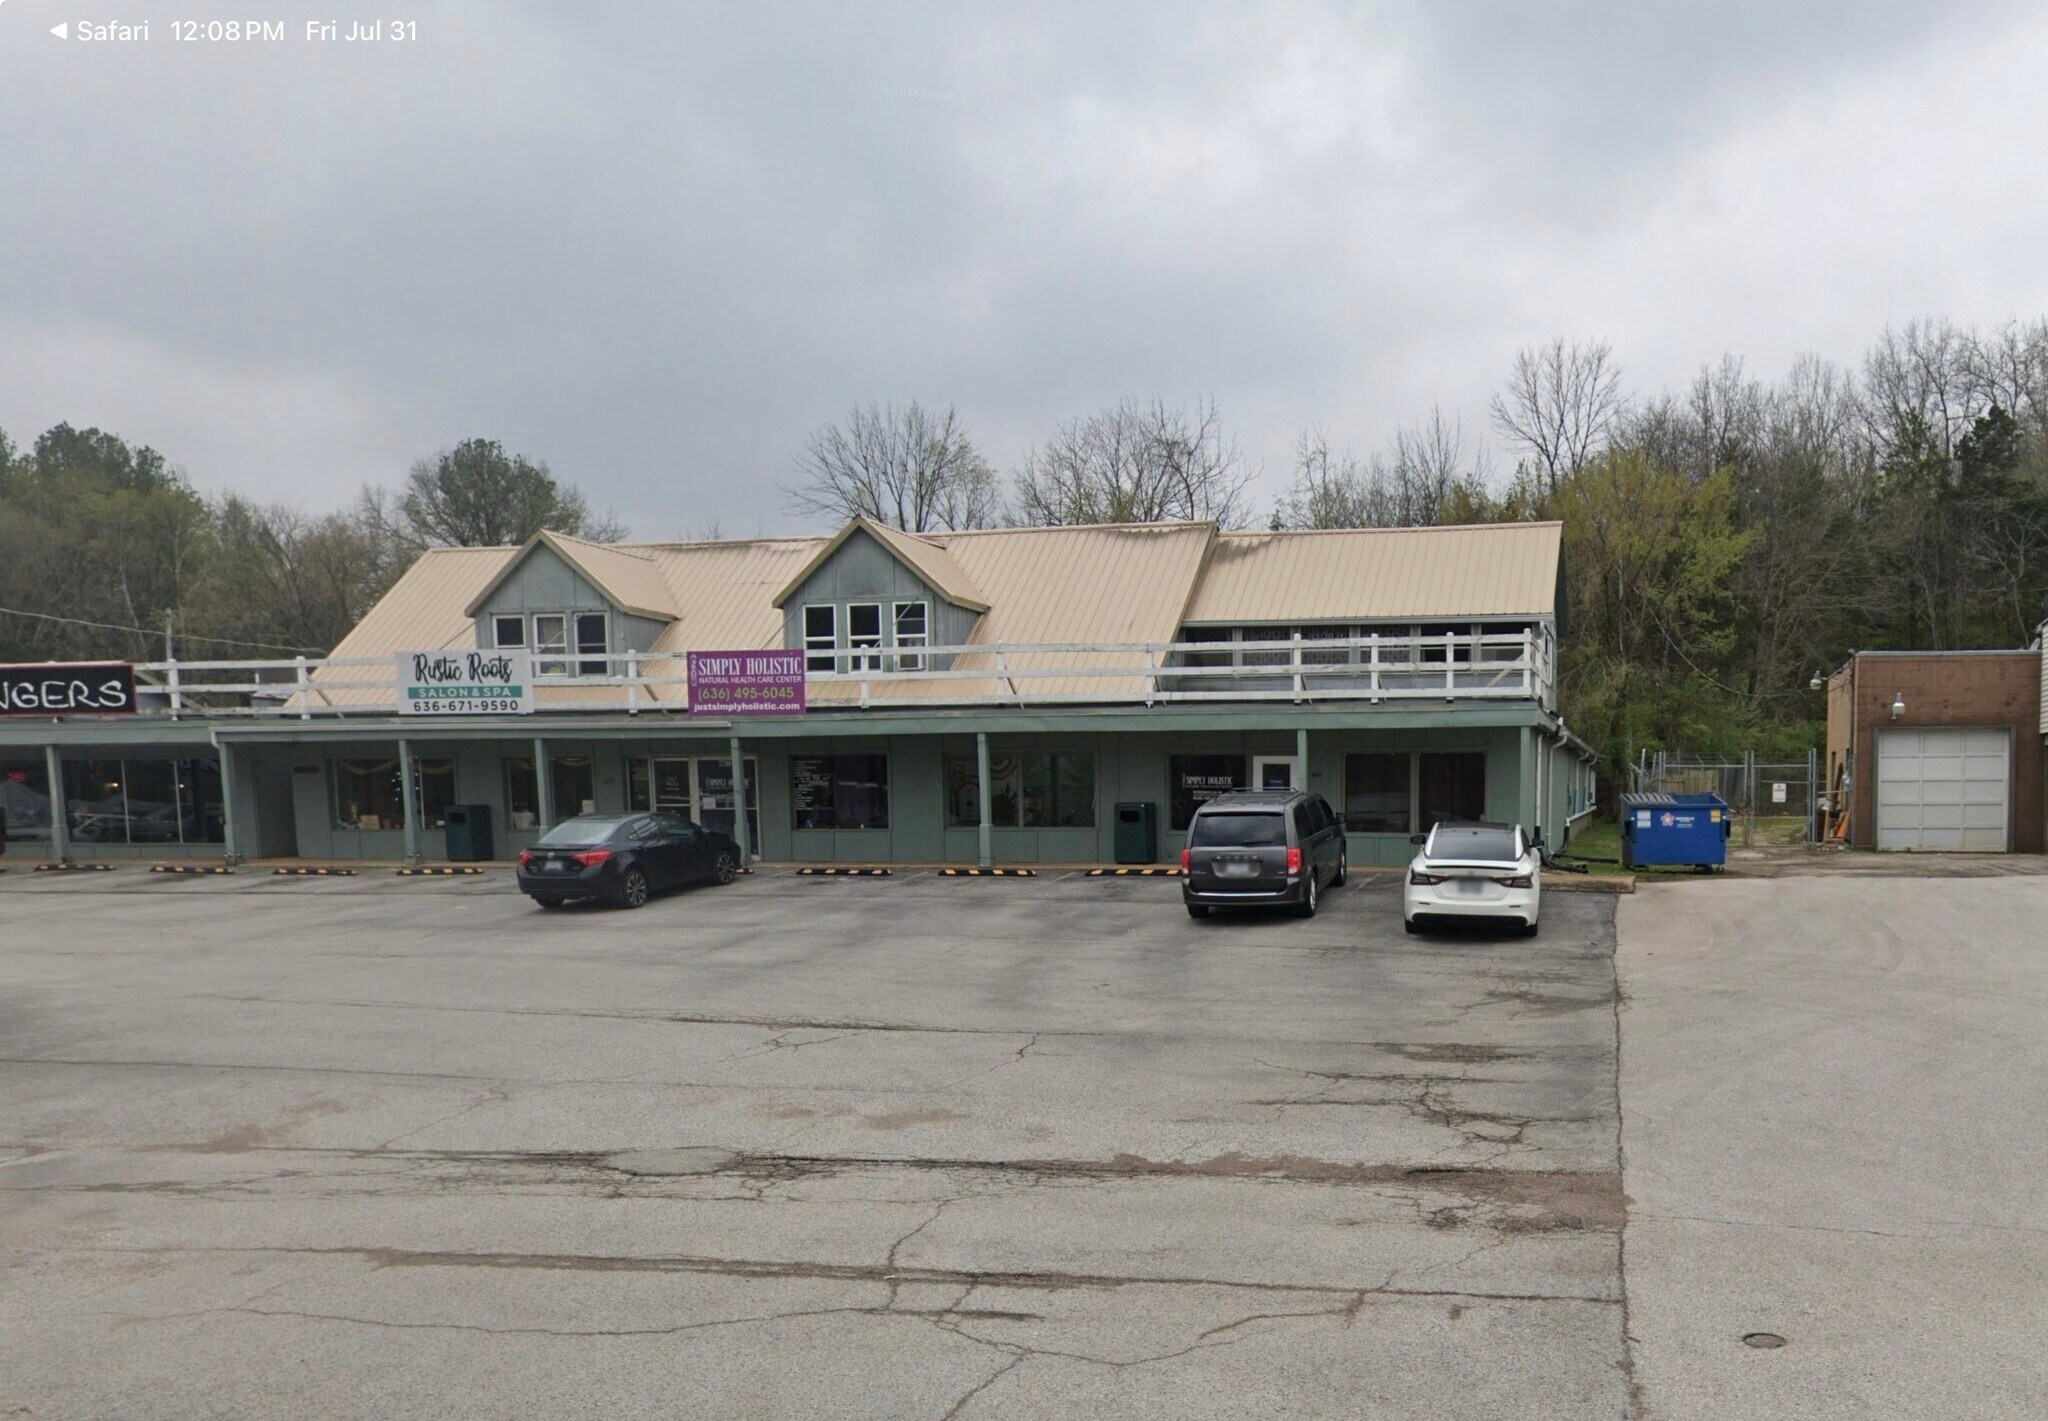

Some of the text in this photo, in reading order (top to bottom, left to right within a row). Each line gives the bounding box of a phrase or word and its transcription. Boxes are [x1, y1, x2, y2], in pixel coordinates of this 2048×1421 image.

[413, 652, 513, 685] Rustic Roots
[698, 658, 742, 676] SIMPLY
[746, 657, 802, 675] HOLISTIC
[698, 675, 802, 684] NATURAL HEALTH CARE CENTER
[419, 688, 468, 698] SALON
[483, 687, 512, 697] SPA
[698, 687, 794, 702] (636) 495-6045
[413, 700, 519, 712] 636-671-9590
[694, 703, 800, 712] justsimplyholistic.com
